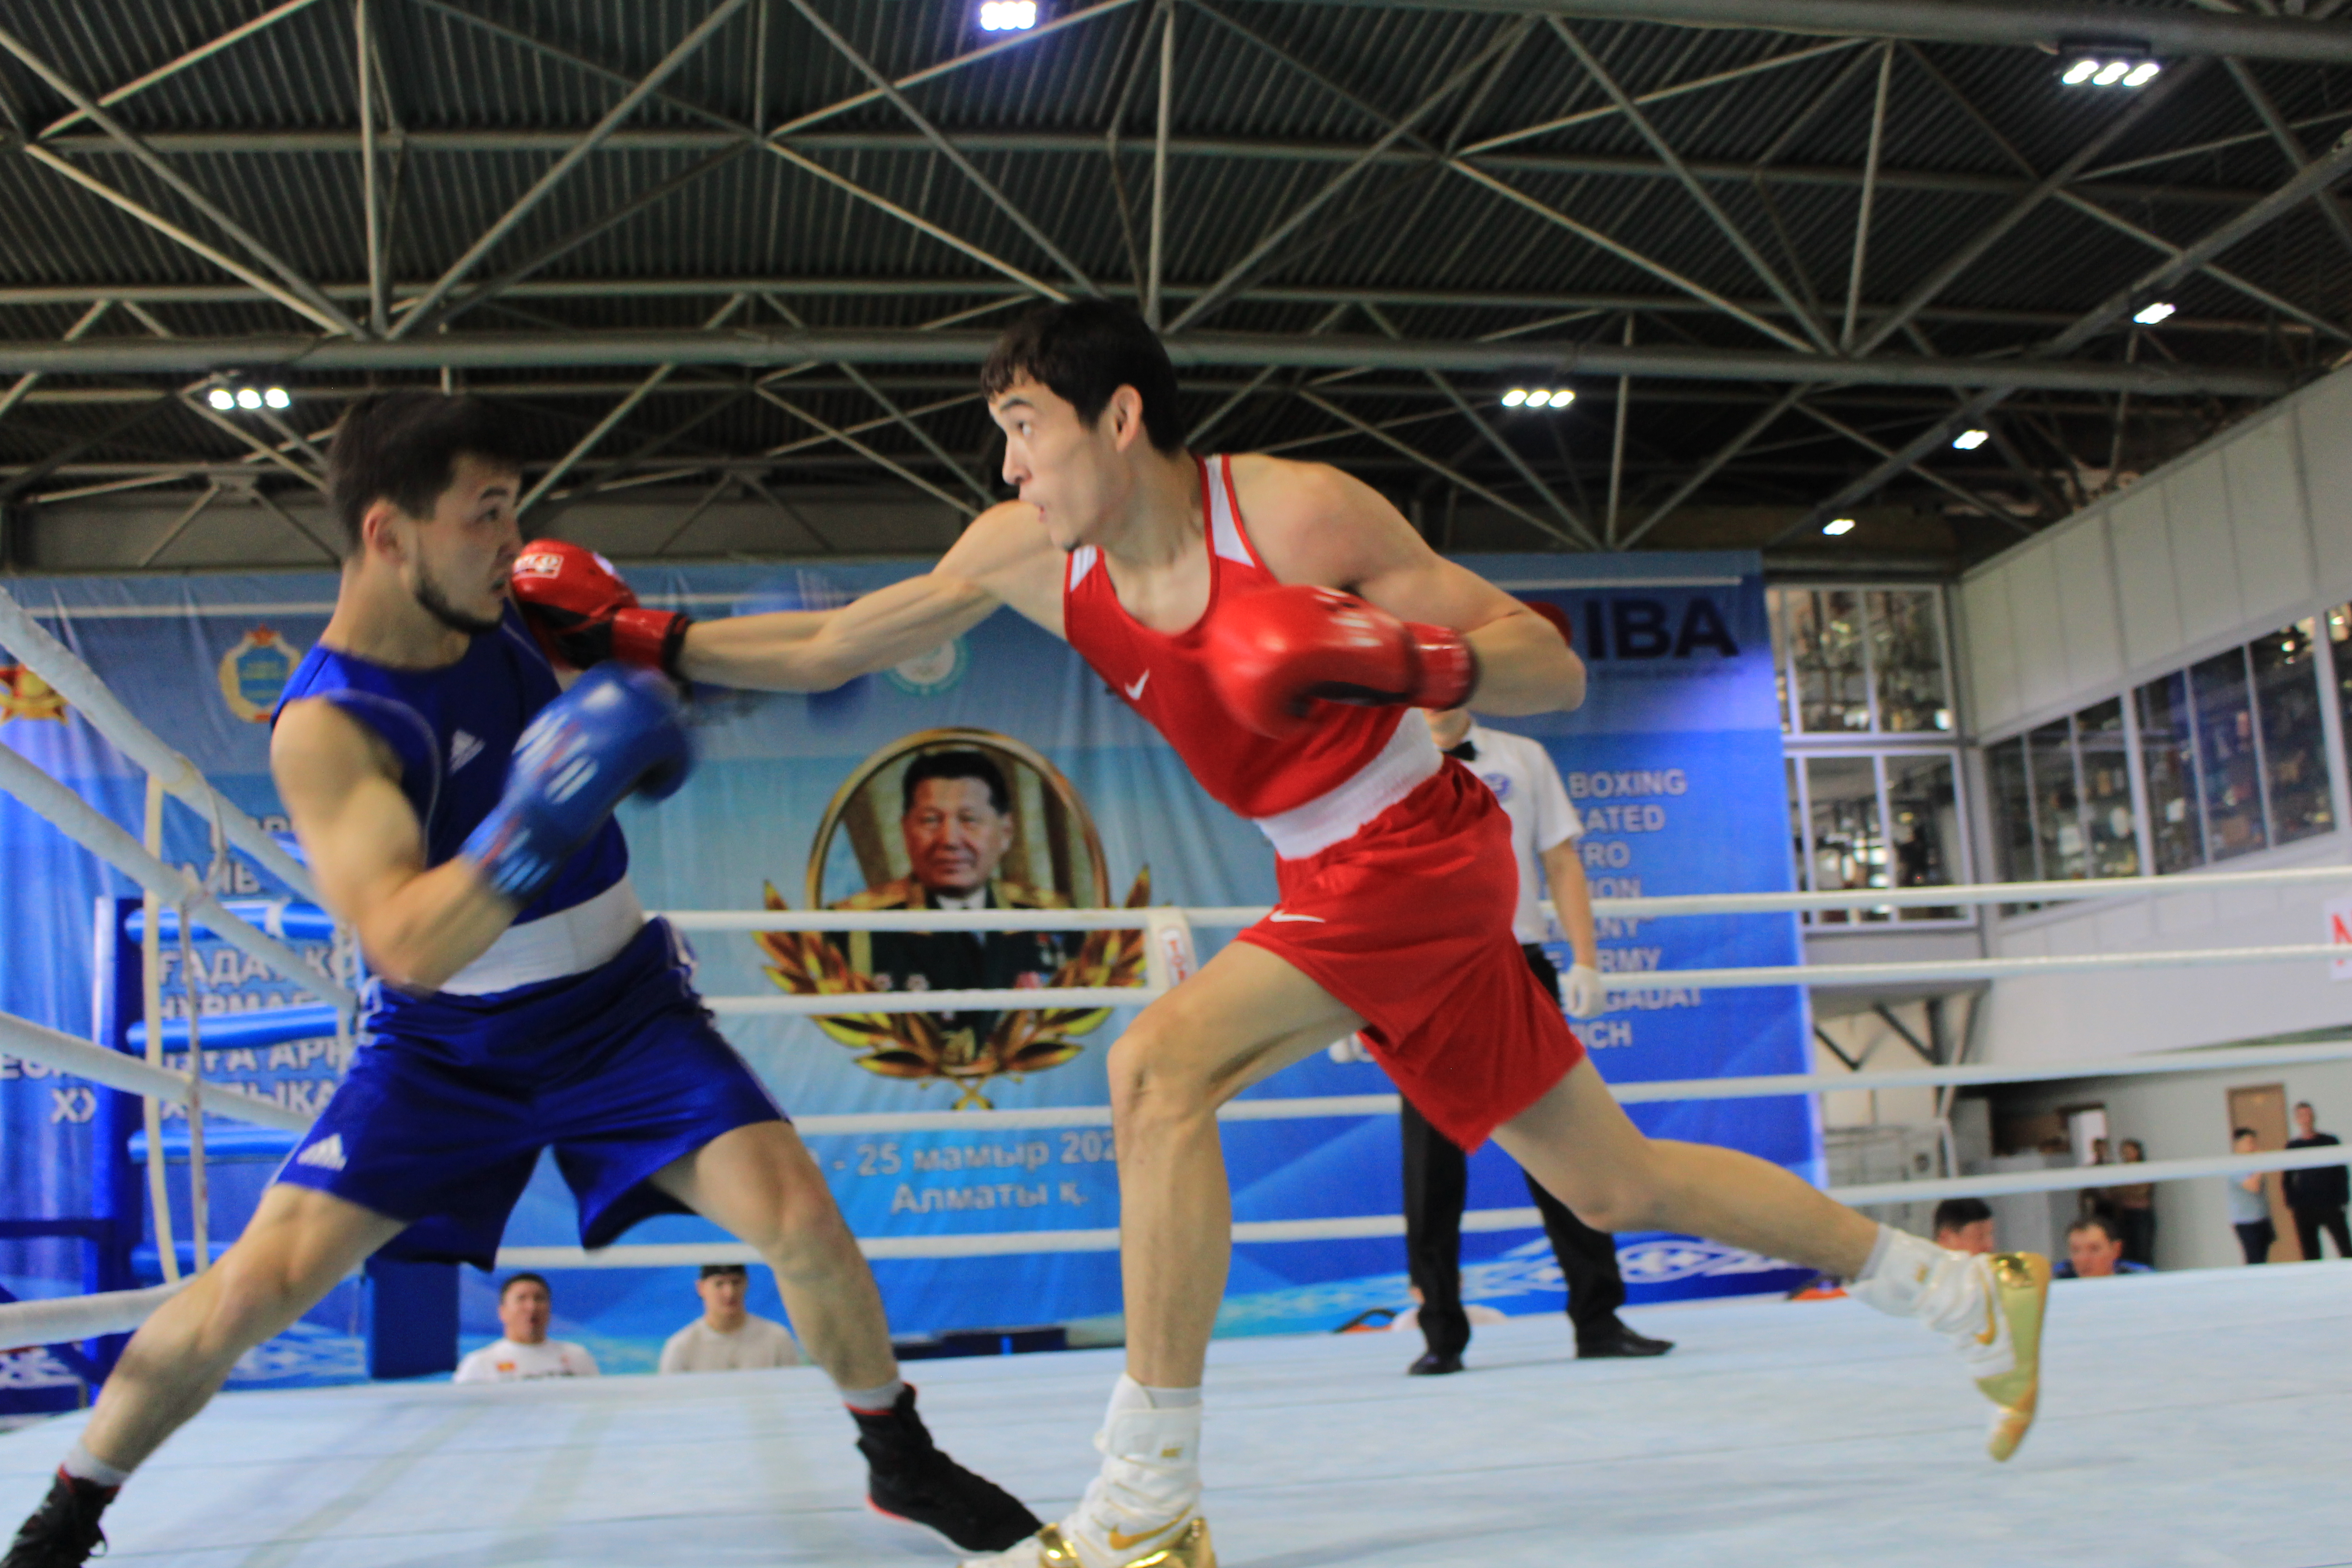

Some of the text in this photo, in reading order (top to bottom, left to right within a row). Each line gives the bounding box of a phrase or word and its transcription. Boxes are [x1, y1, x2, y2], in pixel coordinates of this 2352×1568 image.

[1584, 598, 1739, 660] IBA
[1569, 769, 1688, 799] BOXING
[1577, 804, 1666, 833] ATED
[1579, 840, 1631, 869] RO
[1595, 947, 1662, 972] RMY
[857, 1142, 902, 1176] 25
[912, 1140, 1050, 1174] мамыр
[890, 1182, 1049, 1215] Алматы
